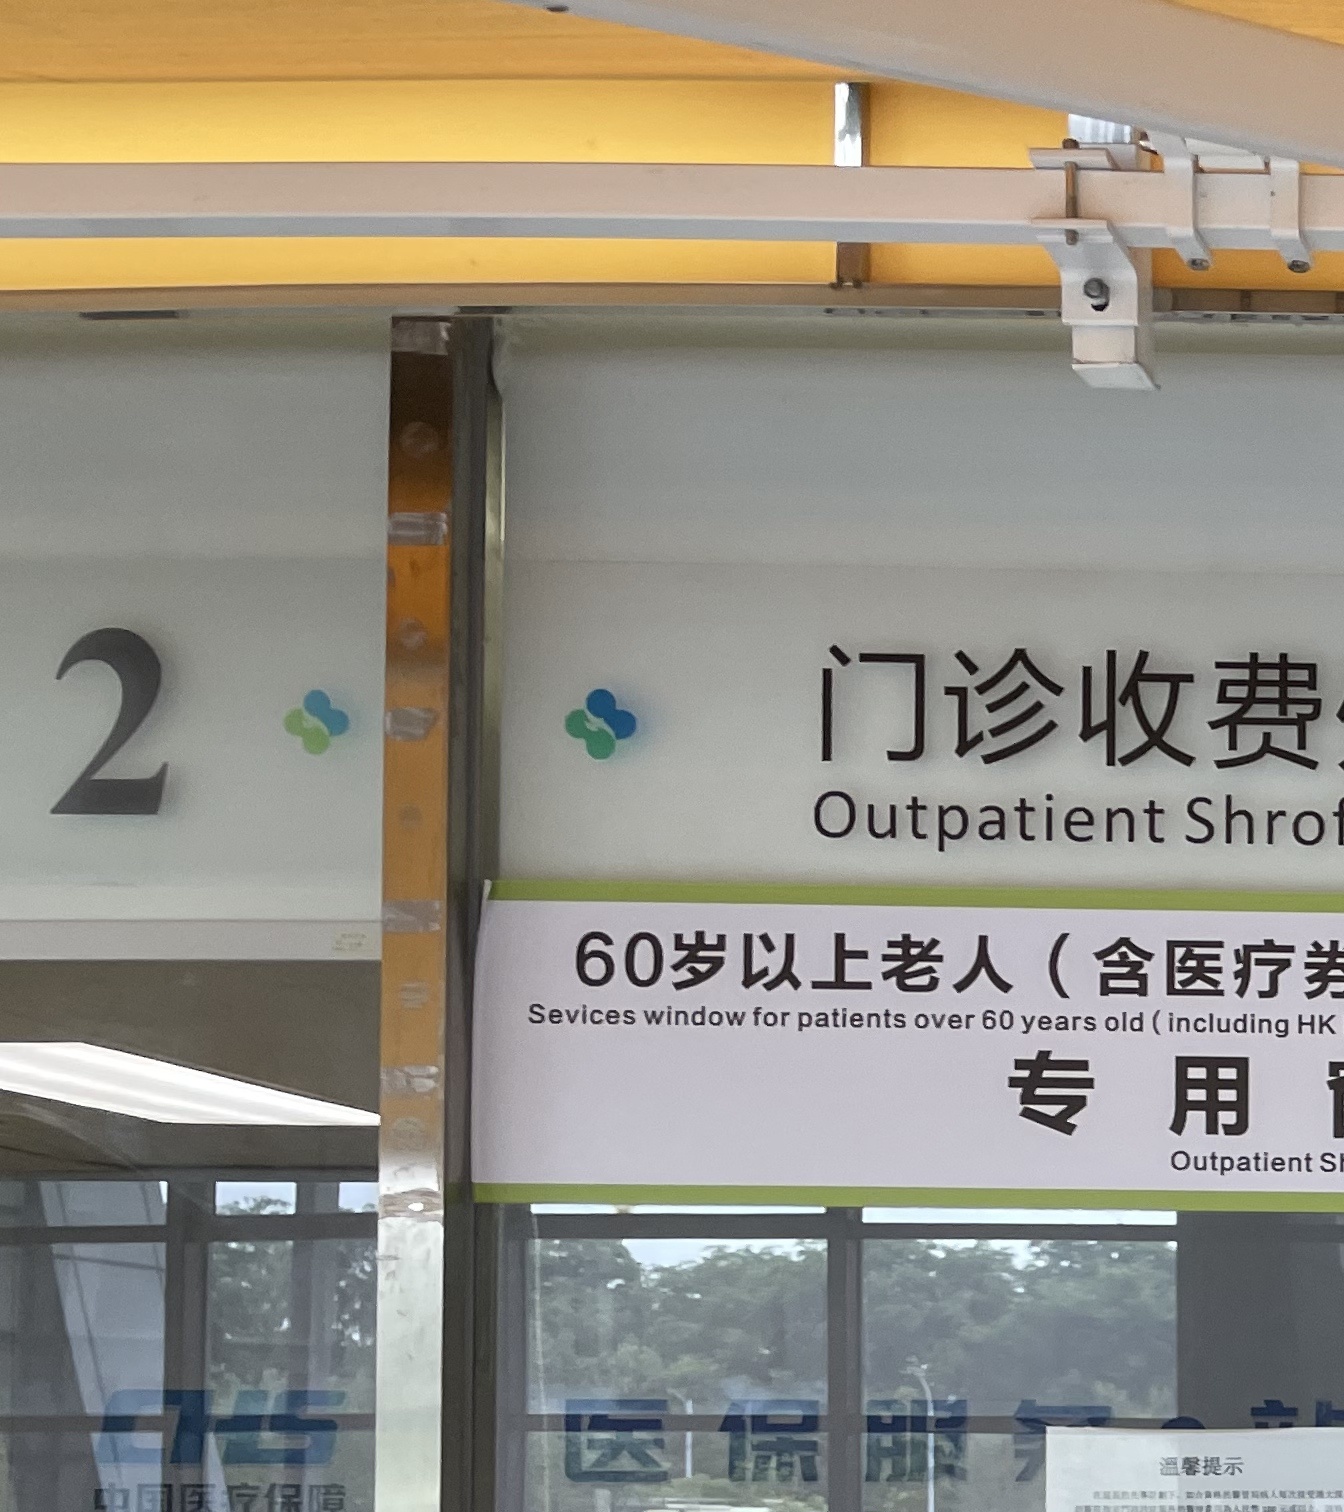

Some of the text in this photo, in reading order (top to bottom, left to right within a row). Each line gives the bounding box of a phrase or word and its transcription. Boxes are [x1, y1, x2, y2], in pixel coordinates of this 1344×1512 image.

[50, 627, 168, 816] 2
[814, 791, 1165, 852] Outpatient
[528, 1004, 635, 1024] Sevices
[644, 1006, 746, 1026] window
[753, 1007, 790, 1026] for
[798, 1008, 906, 1032] patients
[915, 1014, 975, 1029] over
[982, 1010, 1014, 1030] 60
[1021, 1016, 1096, 1035] years
[1105, 1012, 1144, 1032] old
[1297, 1015, 1336, 1034] HK
[1171, 1151, 1312, 1175] Outpatient
